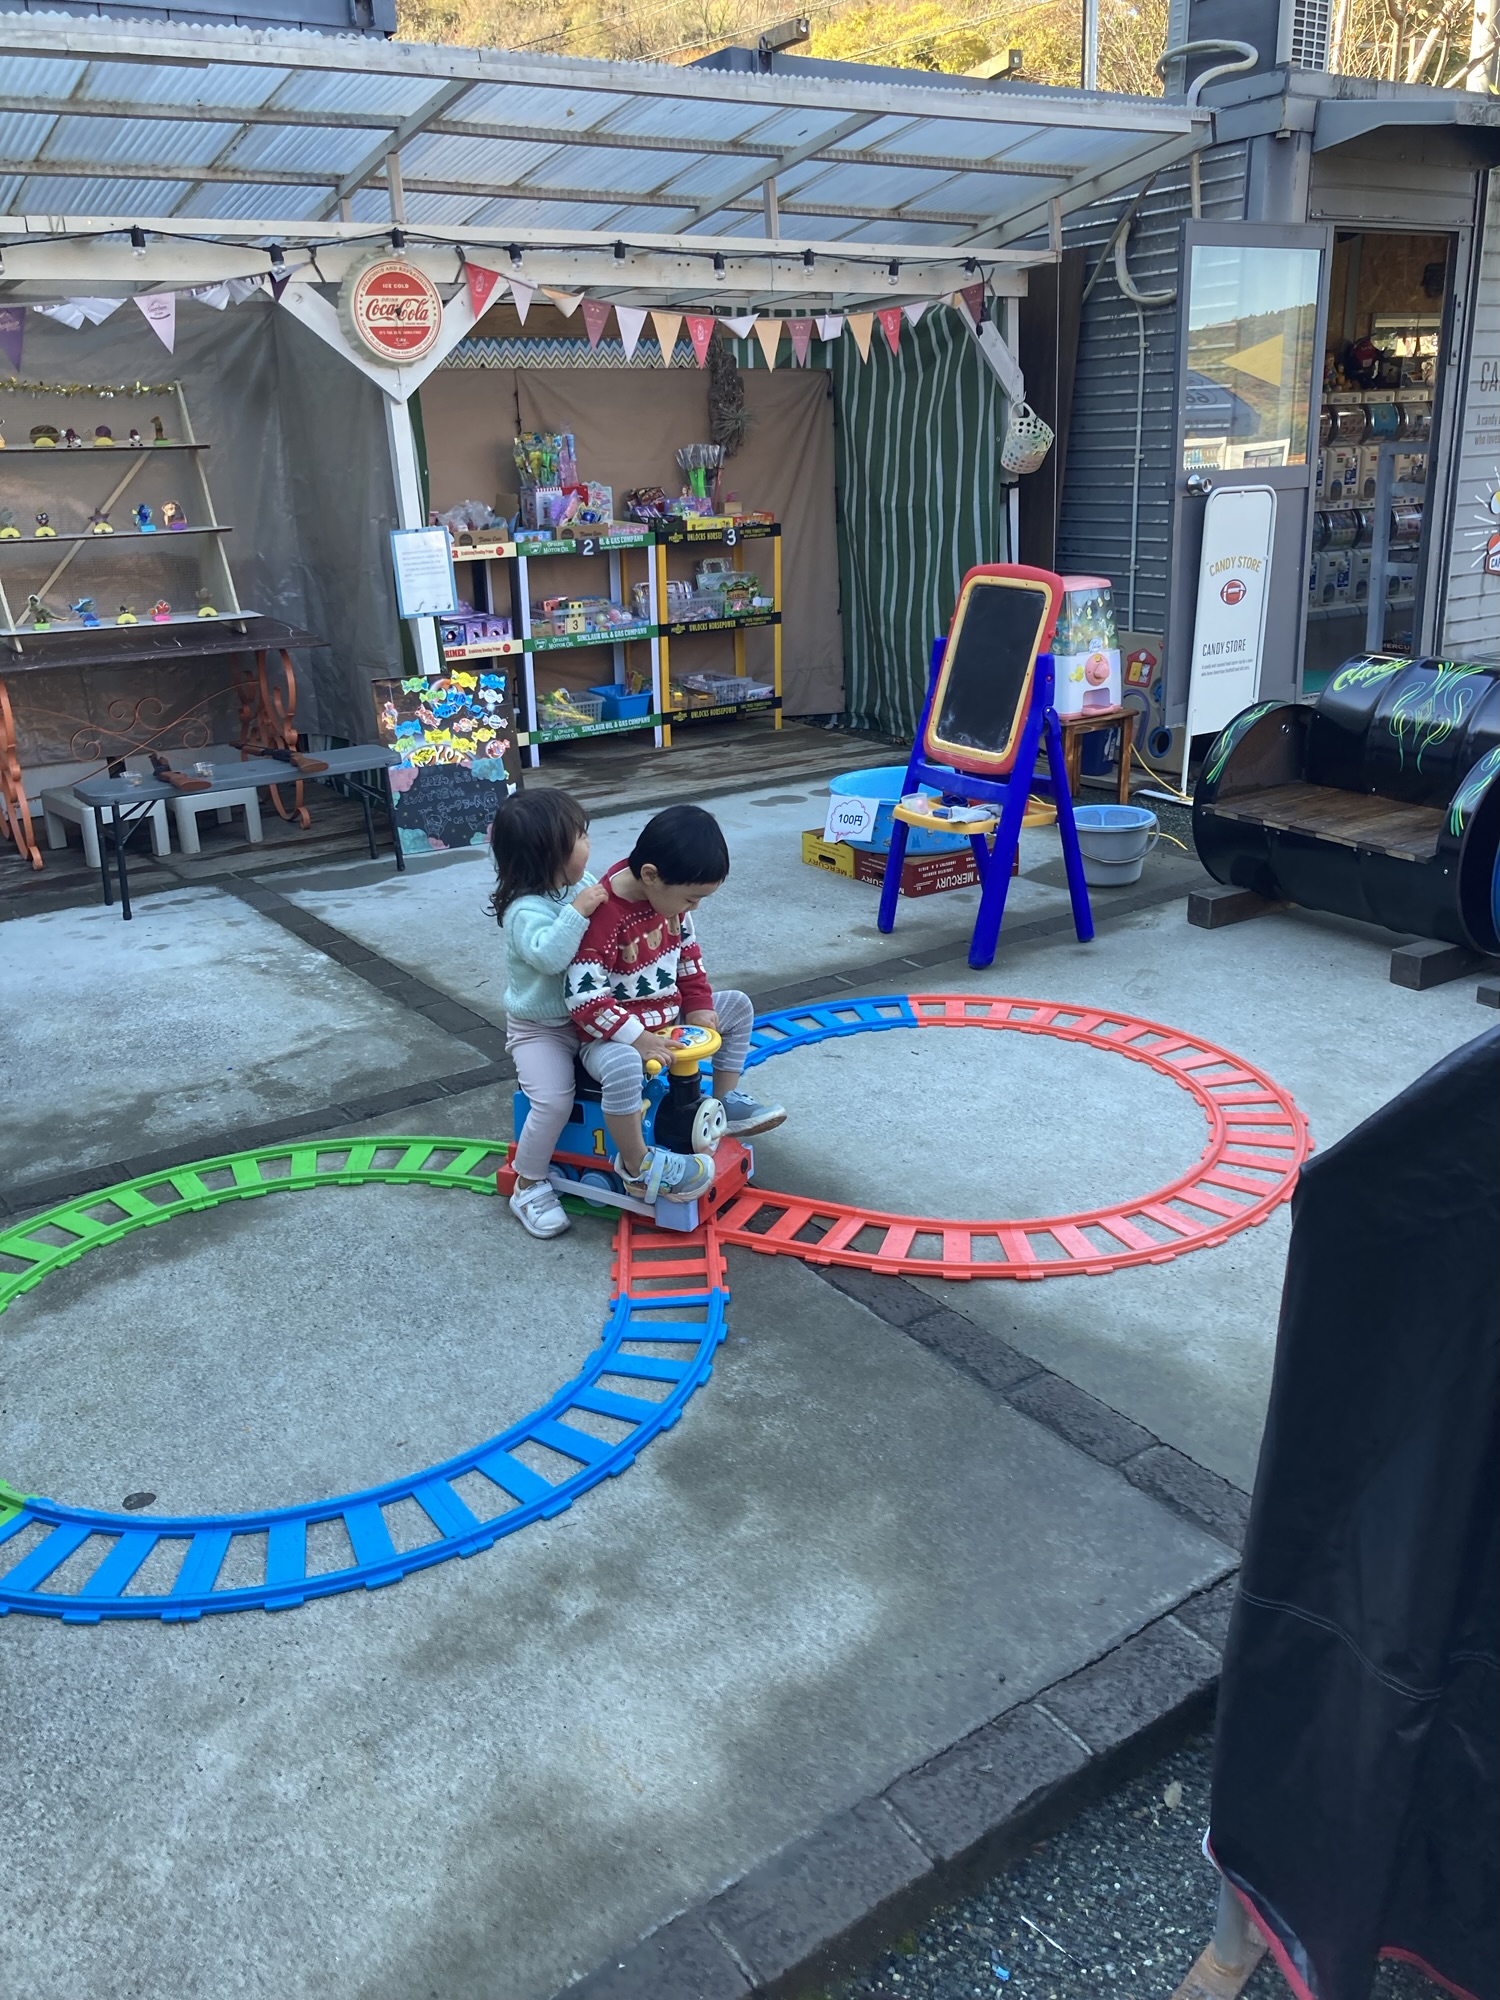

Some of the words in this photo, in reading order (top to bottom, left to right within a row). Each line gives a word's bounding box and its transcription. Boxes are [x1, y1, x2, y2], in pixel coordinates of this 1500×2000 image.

[366, 298, 430, 321] Coca-Cola
[1480, 361, 1500, 392] CA
[1481, 413, 1498, 426] candy
[1475, 435, 1485, 445] who
[611, 536, 620, 544] GAS
[621, 535, 644, 543] COMPANY
[687, 532, 706, 541] UNLOCKS
[707, 532, 723, 540] HORSE
[727, 528, 737, 546] 3
[583, 539, 594, 555] 2
[1210, 557, 1238, 577] CANDY
[1238, 556, 1262, 573] STORE
[572, 620, 579, 630] 3
[689, 624, 707, 632] UNLOCKS
[709, 620, 736, 630] HORSEPOWER
[610, 631, 614, 639] &
[615, 630, 624, 638] GAS
[625, 628, 647, 636] COMPANY
[445, 649, 466, 658] RIMER
[1202, 642, 1225, 656] CANDY
[1226, 639, 1246, 654] STORE
[691, 709, 709, 719] UNLOCKS
[710, 706, 737, 717] HORSEPOWER
[582, 724, 605, 732] SINCLAIR
[629, 716, 651, 726] COMPANY
[839, 814, 863, 826] 100円
[808, 858, 847, 876] MERCURY
[861, 875, 905, 894] MCURY
[935, 872, 974, 889] MERCURY
[592, 1128, 606, 1156] 1
